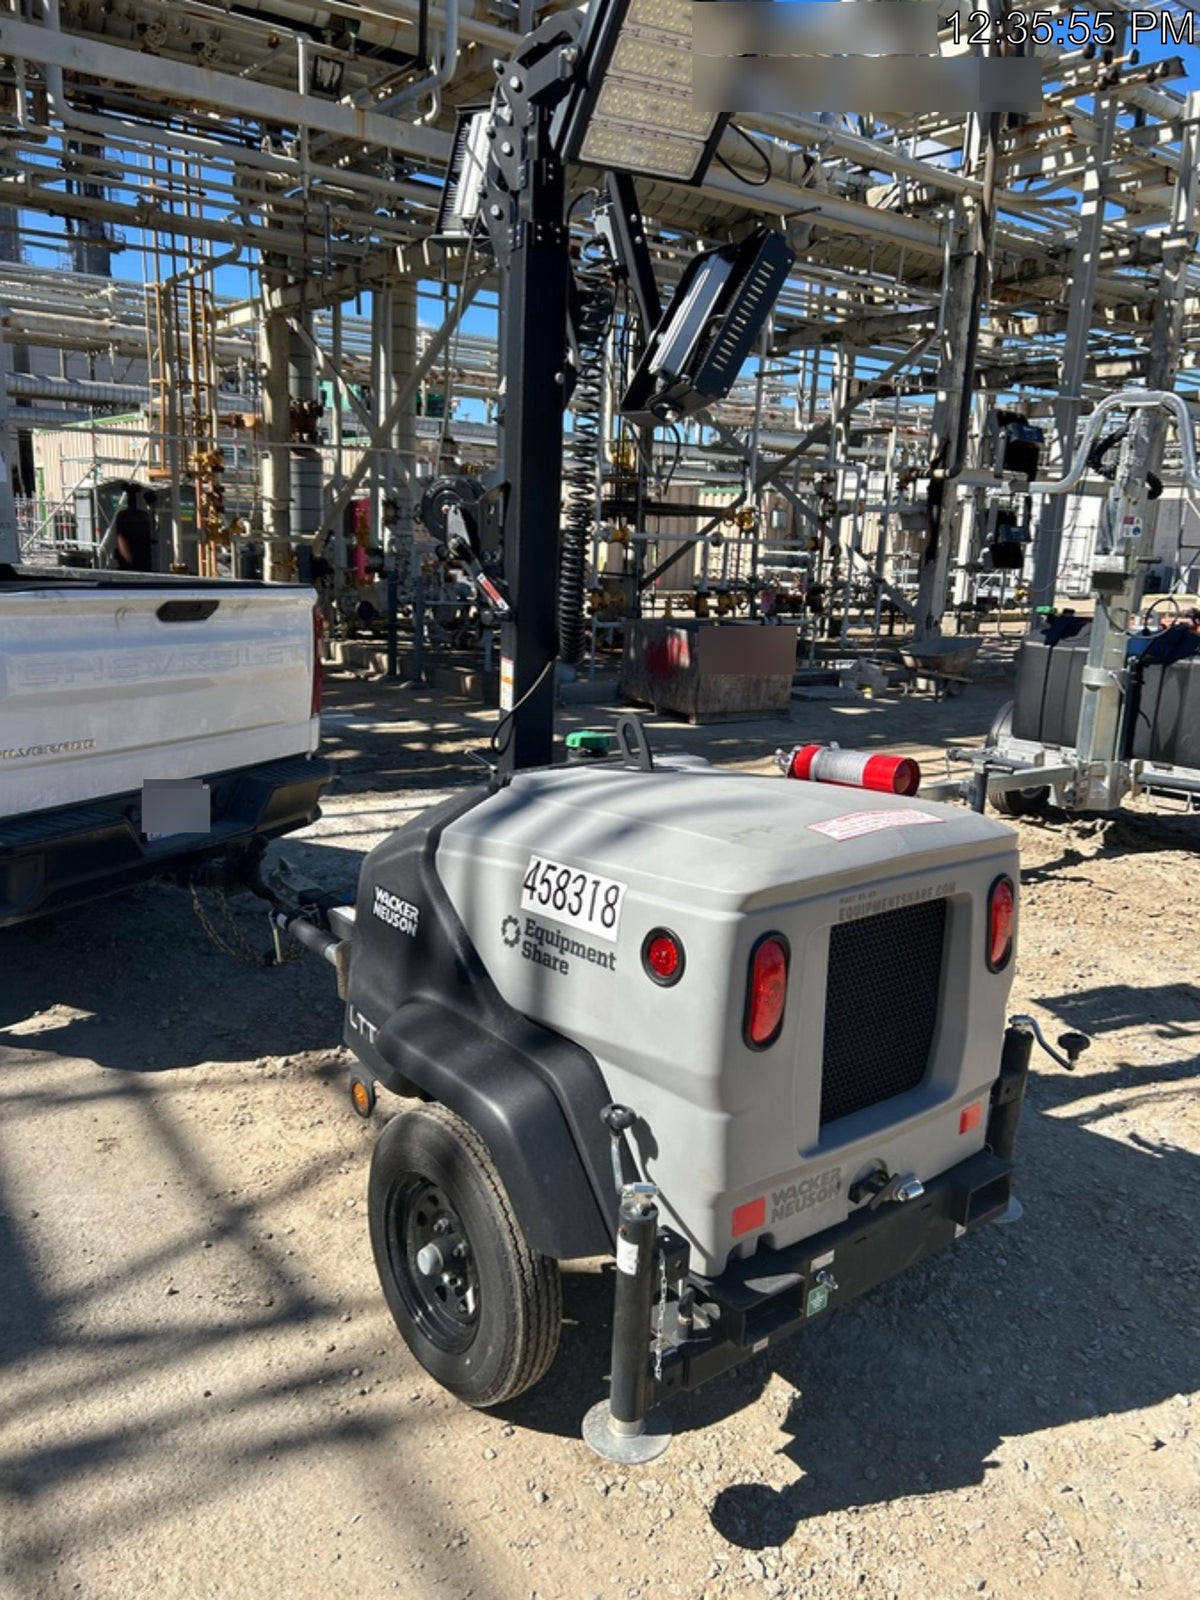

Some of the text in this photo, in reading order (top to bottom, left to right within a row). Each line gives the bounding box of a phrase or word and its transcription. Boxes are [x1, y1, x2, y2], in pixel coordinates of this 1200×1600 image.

[19, 643, 306, 686] CHEVROLET
[374, 886, 420, 922] WACKER
[523, 860, 620, 929] 458318
[372, 901, 418, 938] NEUSON
[522, 939, 570, 976] Share
[524, 917, 617, 972] Equipment
[350, 1004, 381, 1045] LTT
[771, 1167, 842, 1207] WACKER
[771, 1181, 841, 1225] NEUSON
